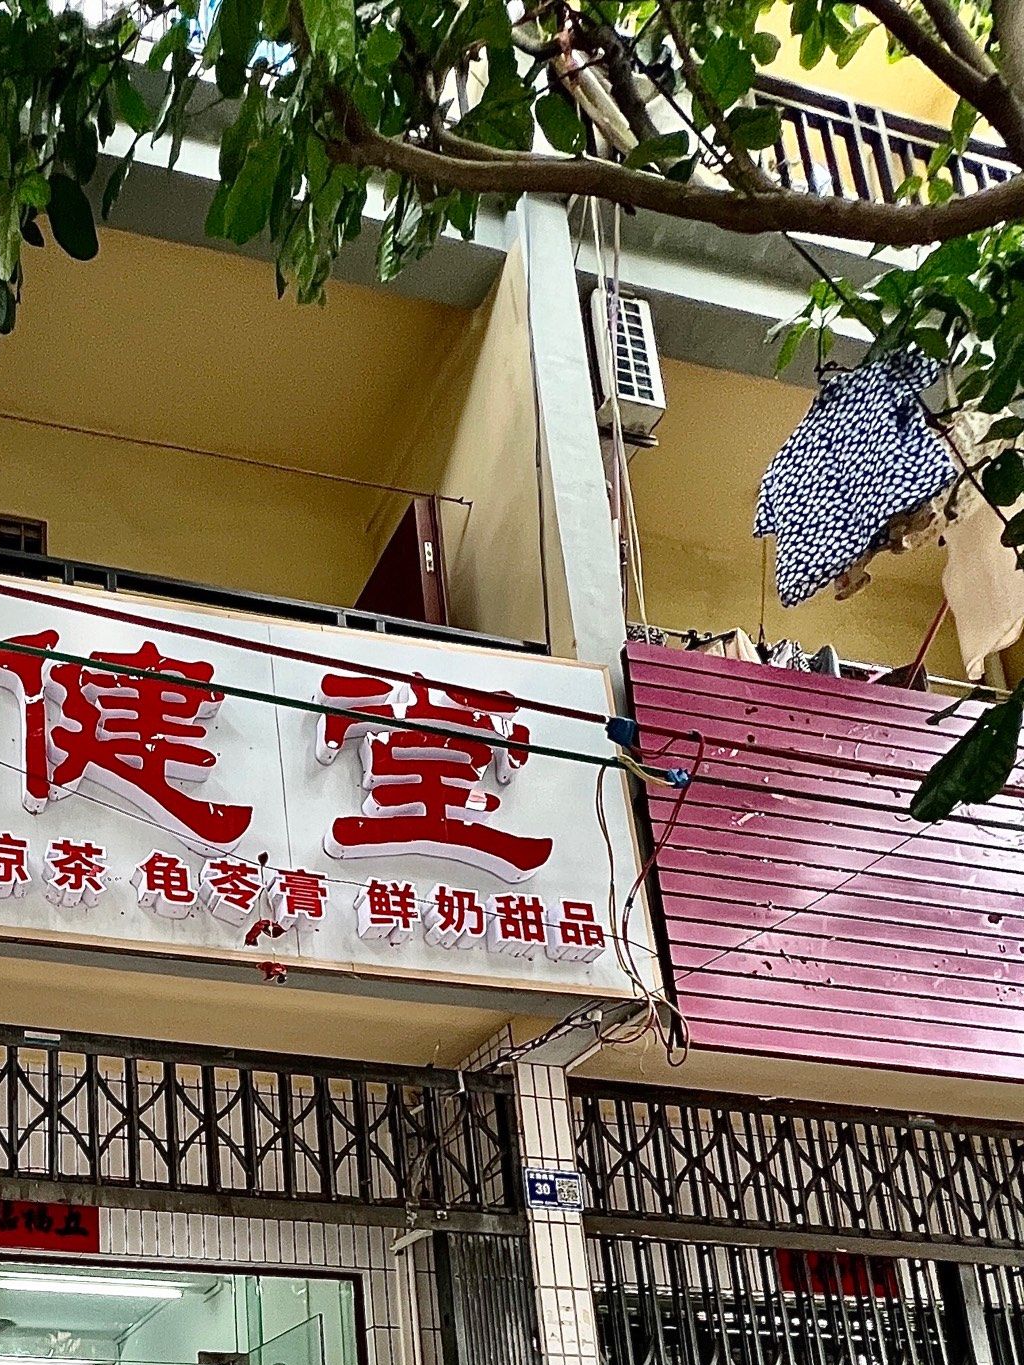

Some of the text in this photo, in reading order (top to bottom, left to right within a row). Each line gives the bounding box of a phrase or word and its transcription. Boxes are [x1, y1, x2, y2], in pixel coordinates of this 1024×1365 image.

[143, 852, 326, 919] 龟苓膏
[366, 882, 604, 946] 鲜奶甜品
[535, 1182, 551, 1195] 30
